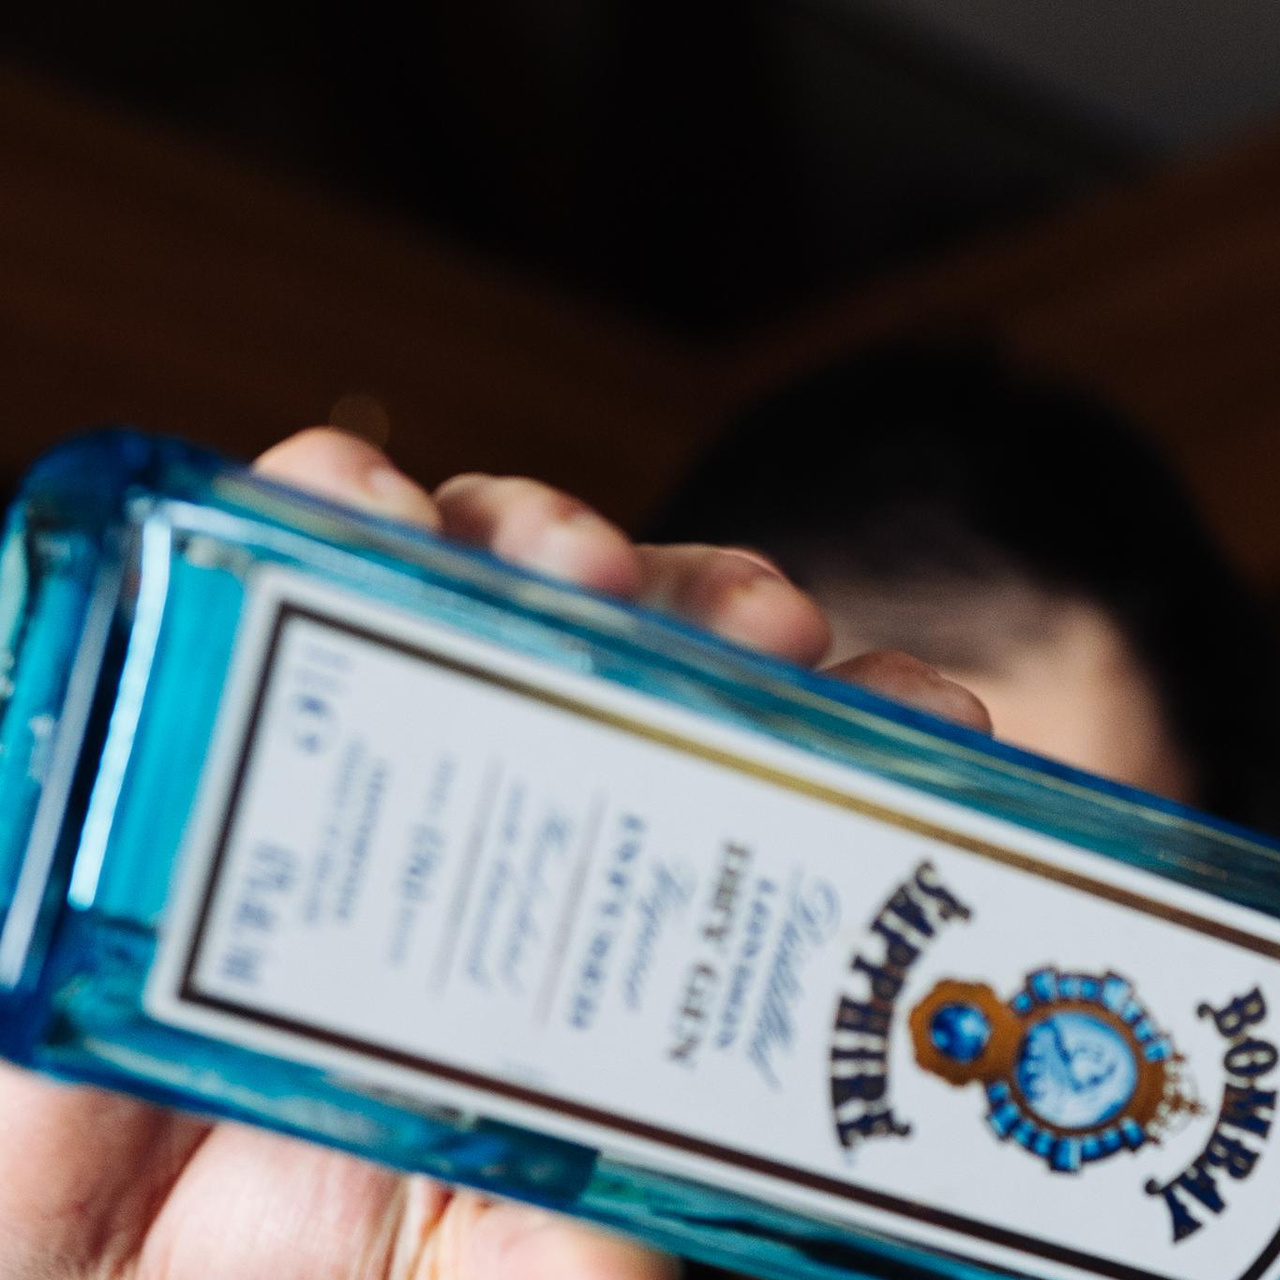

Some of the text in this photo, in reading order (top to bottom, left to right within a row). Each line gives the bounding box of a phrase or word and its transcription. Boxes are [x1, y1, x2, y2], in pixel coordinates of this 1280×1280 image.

[667, 838, 753, 1070] DRY GIN
[829, 858, 973, 1148] SAPPHIRE
[1144, 985, 1280, 1244] BOMBAY
